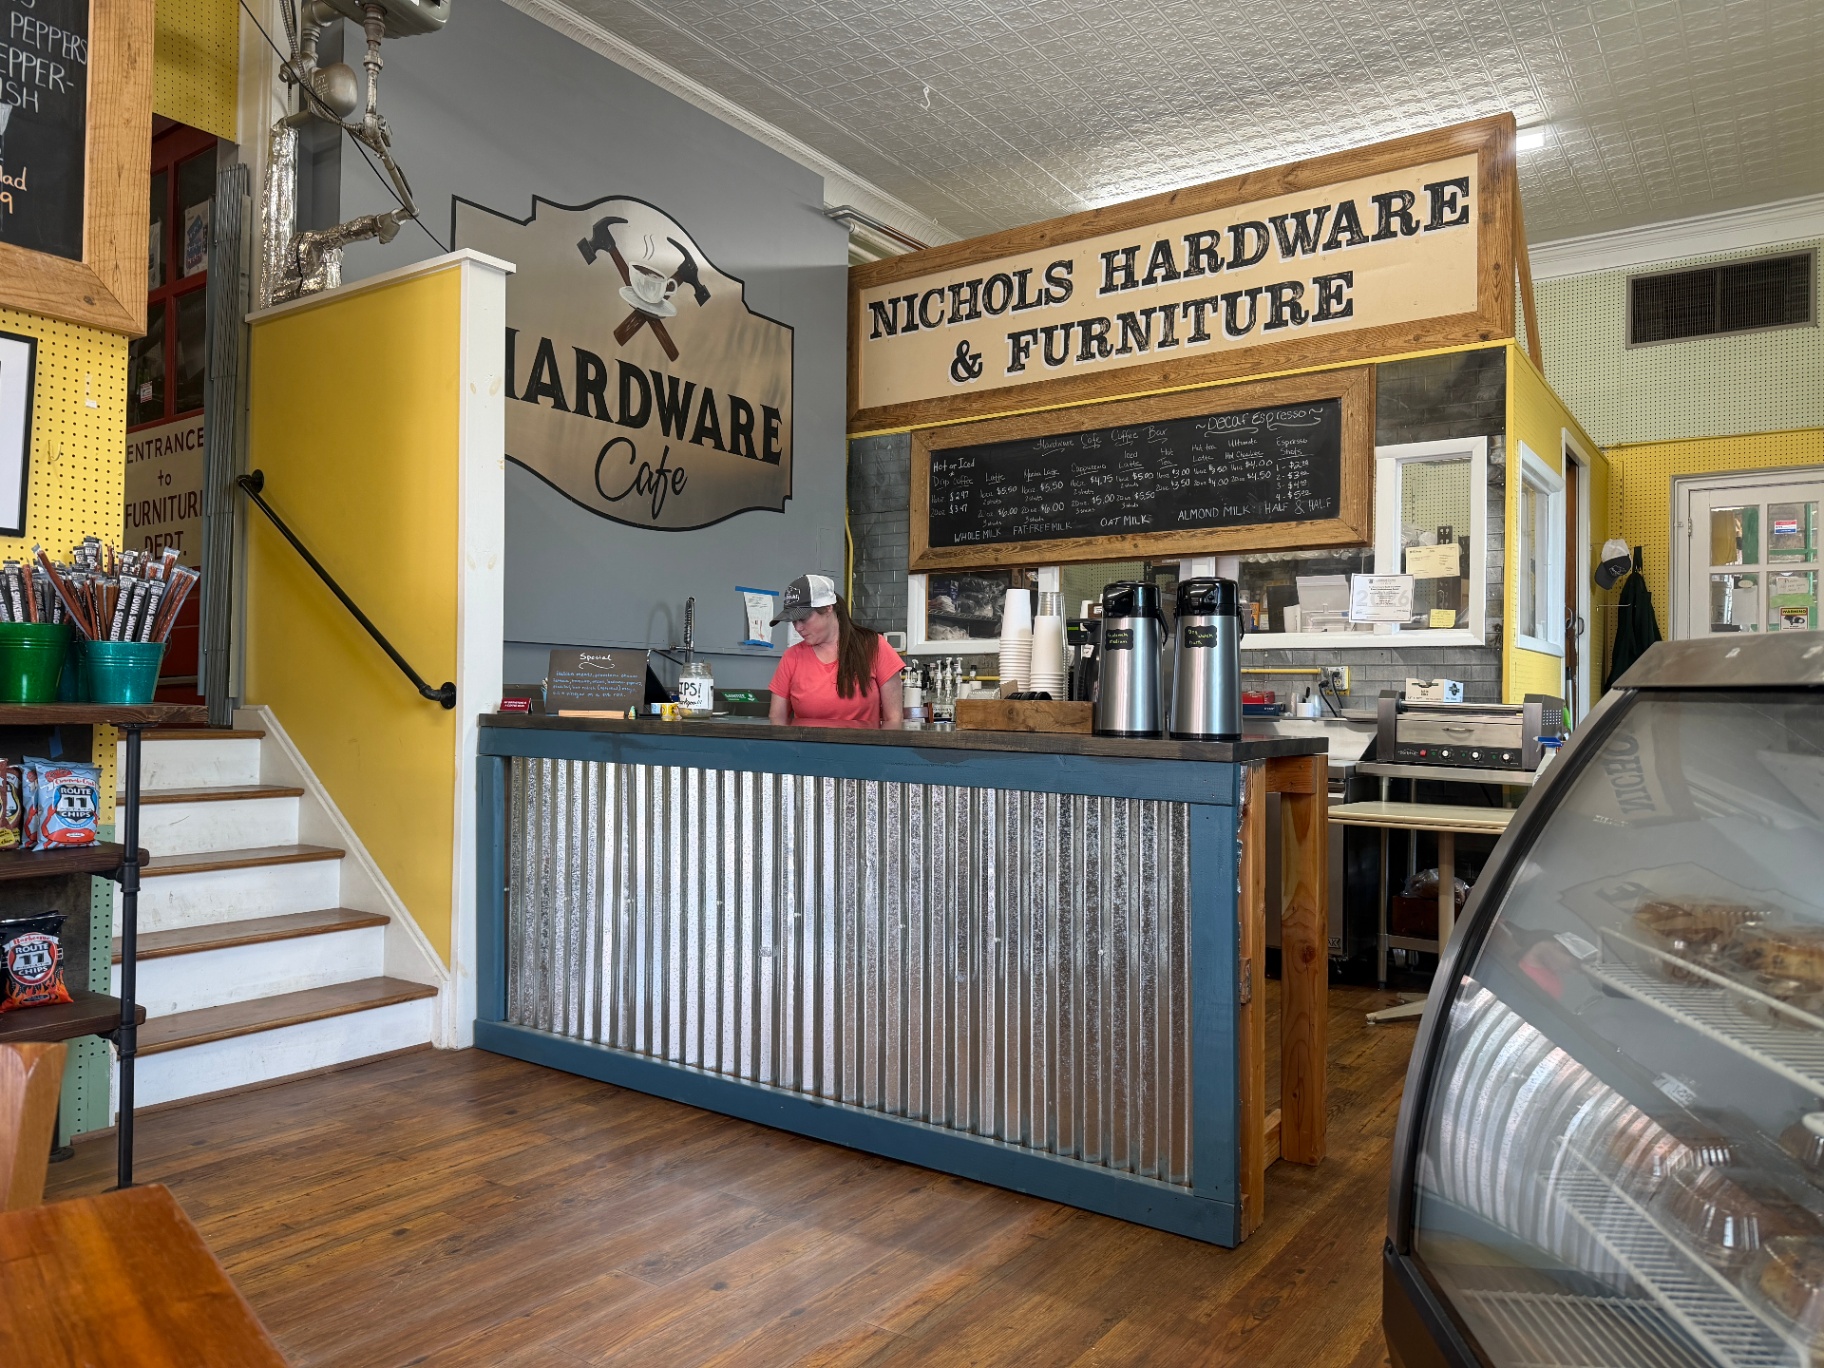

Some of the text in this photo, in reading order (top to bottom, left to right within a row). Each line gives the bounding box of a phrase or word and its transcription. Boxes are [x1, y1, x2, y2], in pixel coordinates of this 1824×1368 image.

[11, 11, 87, 65] PEPPERS
[868, 176, 1471, 342] NICHOLS HARDWARE
[950, 270, 1355, 384] & FURNITURE
[127, 427, 204, 464] ENTRANCE
[1276, 436, 1308, 448] Espresso
[933, 460, 947, 473] Hot
[958, 458, 975, 469] Iced
[158, 469, 172, 486] to
[594, 436, 688, 520] Cafe
[1177, 504, 1251, 521] ALMOND MILK
[1264, 497, 1331, 514] HALF & HALF
[1013, 520, 1073, 536] FAT-FREE MILK
[1100, 514, 1151, 527] OAT MILK
[954, 528, 1002, 543] WHOLE MILK
[144, 530, 187, 561] DEPT.
[116, 589, 129, 610] IOWA
[129, 595, 142, 615] IOWA
[147, 595, 160, 615] IOWA
[579, 652, 612, 661] Special
[60, 787, 91, 795] ROUTE
[64, 796, 87, 808] 11
[15, 943, 49, 954] ROUTE
[19, 952, 45, 965] 11
[18, 966, 48, 976] CHIPS
